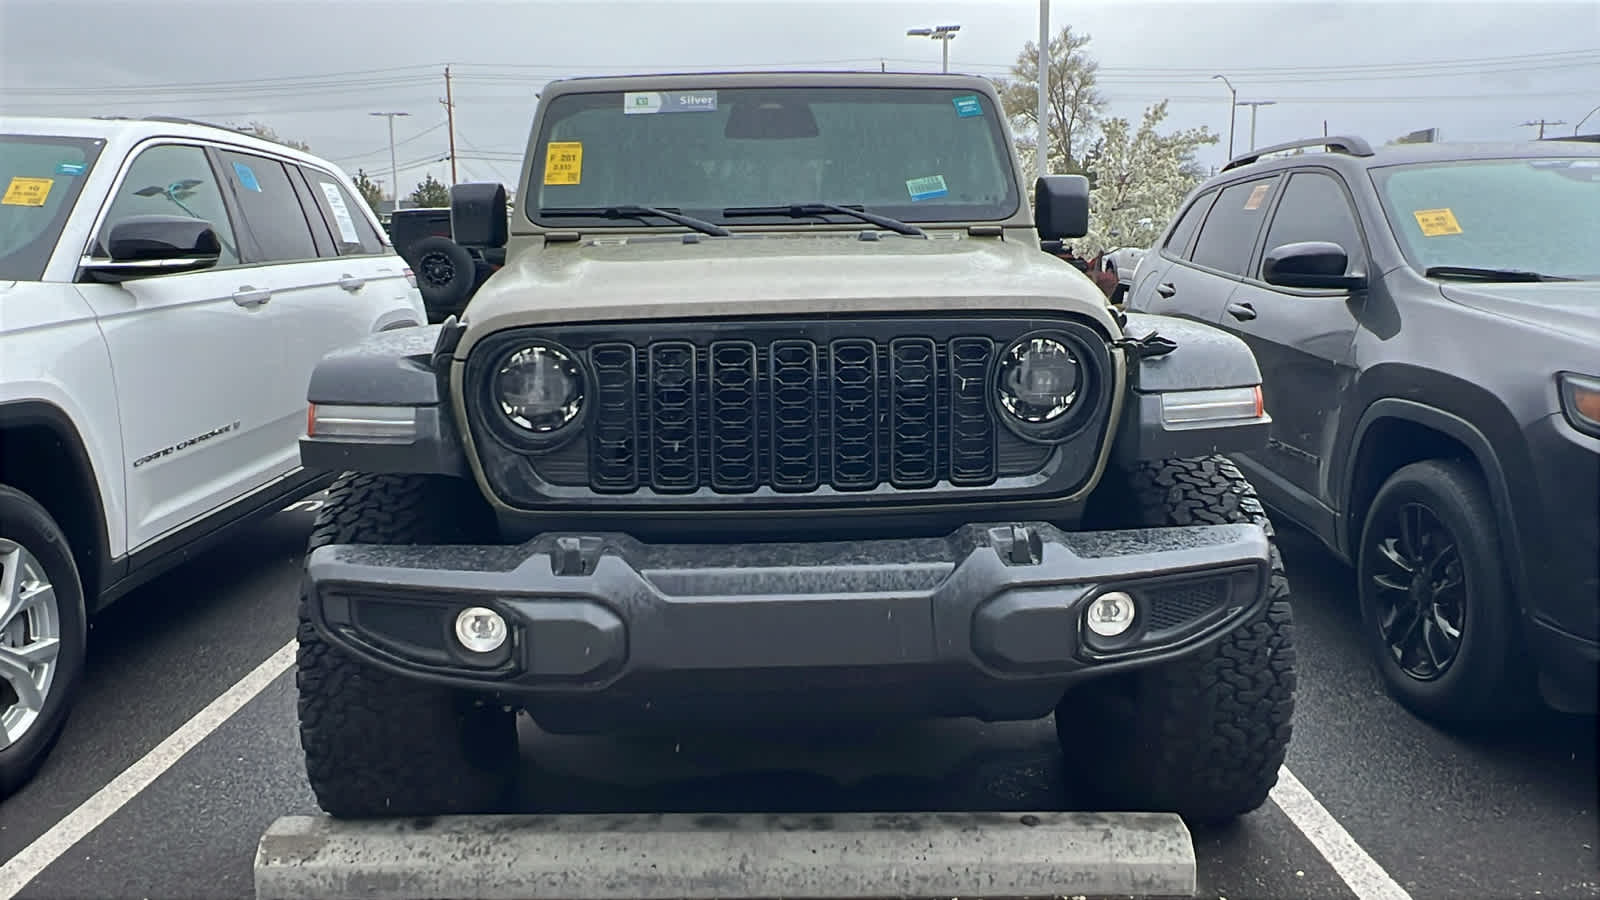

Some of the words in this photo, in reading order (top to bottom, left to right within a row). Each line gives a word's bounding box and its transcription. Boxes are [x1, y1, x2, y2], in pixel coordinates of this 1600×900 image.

[680, 95, 713, 105] Silver
[133, 446, 174, 468] GRAND
[176, 424, 231, 451] CHEROKEE
